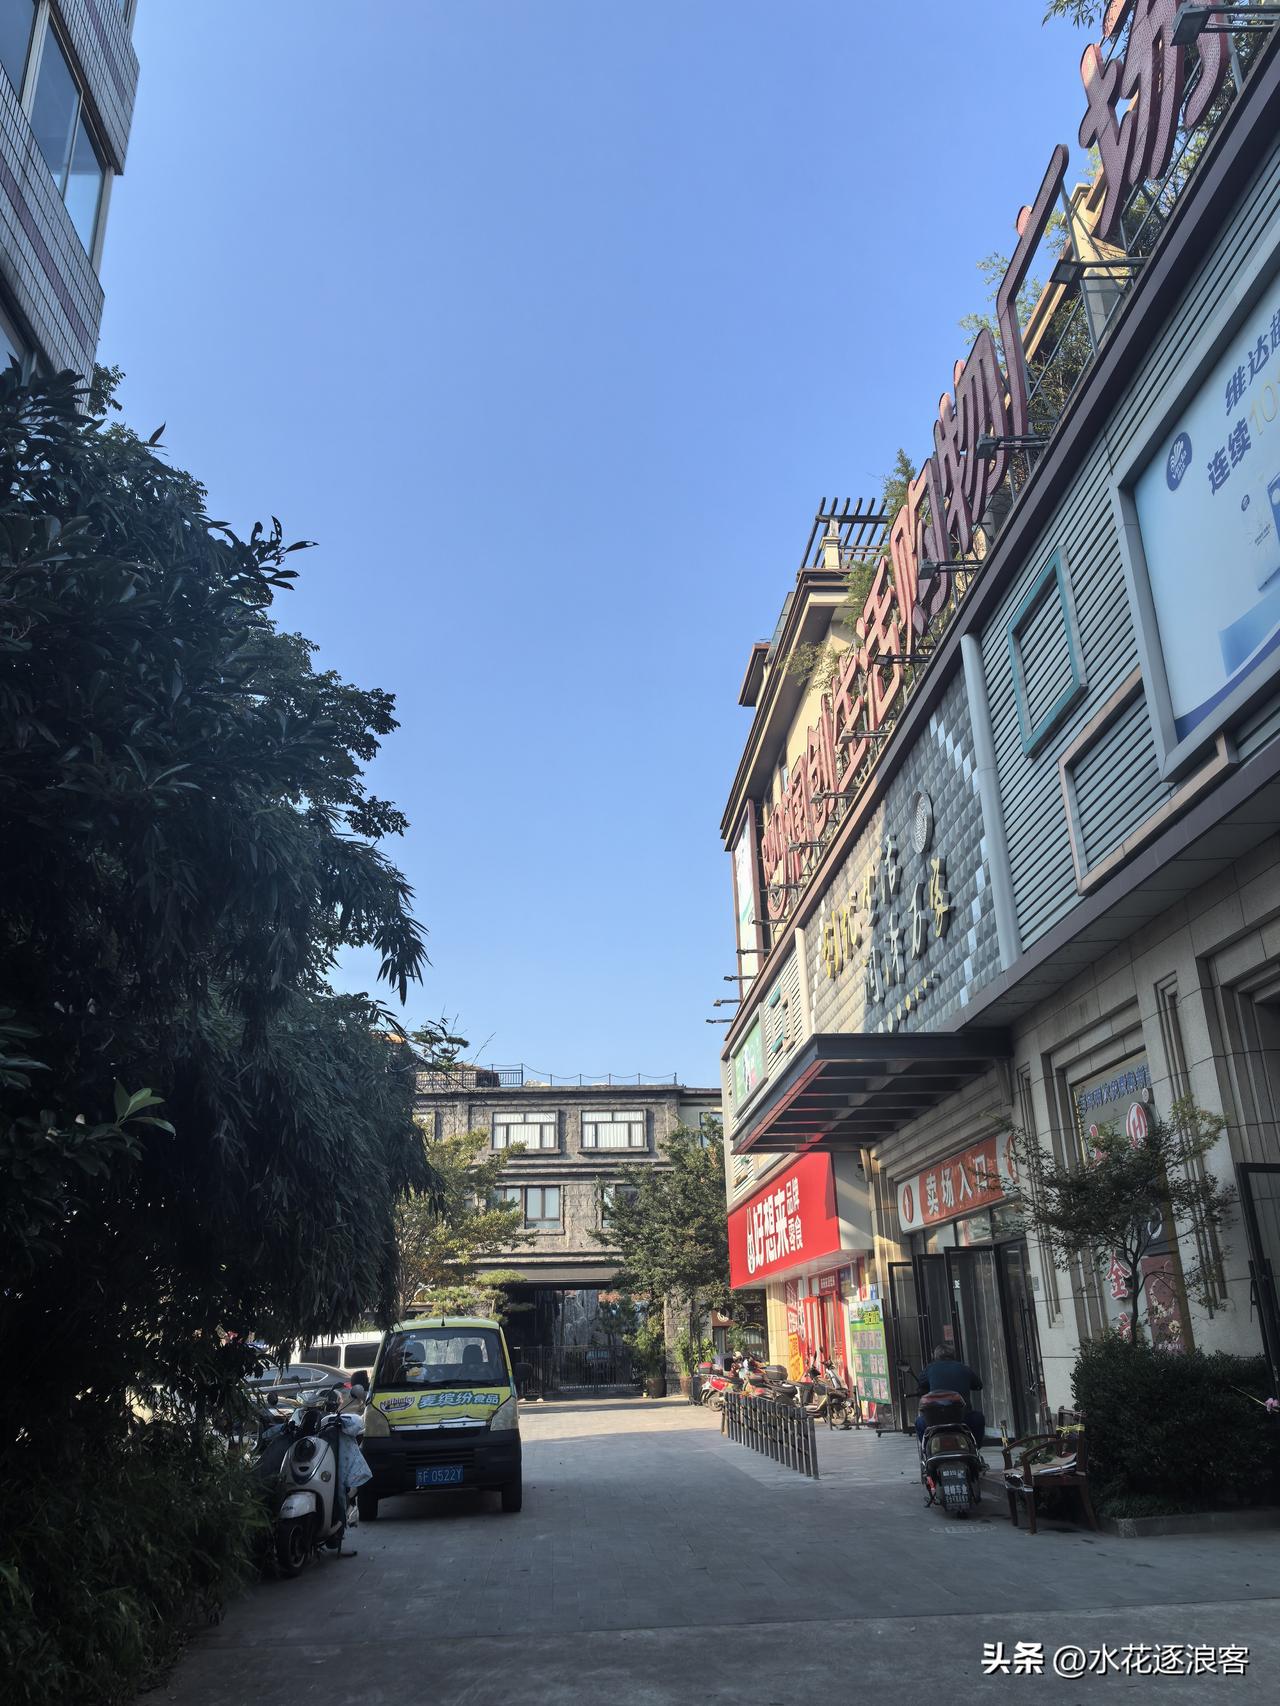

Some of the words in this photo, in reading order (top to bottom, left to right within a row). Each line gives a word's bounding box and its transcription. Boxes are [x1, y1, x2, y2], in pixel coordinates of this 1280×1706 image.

[786, 1177, 800, 1216] 品牌
[926, 1154, 988, 1217] 卖场入口
[752, 1188, 789, 1268] 好想来
[788, 1215, 804, 1252] 零食
[419, 1392, 500, 1410] 麦缤纷食品
